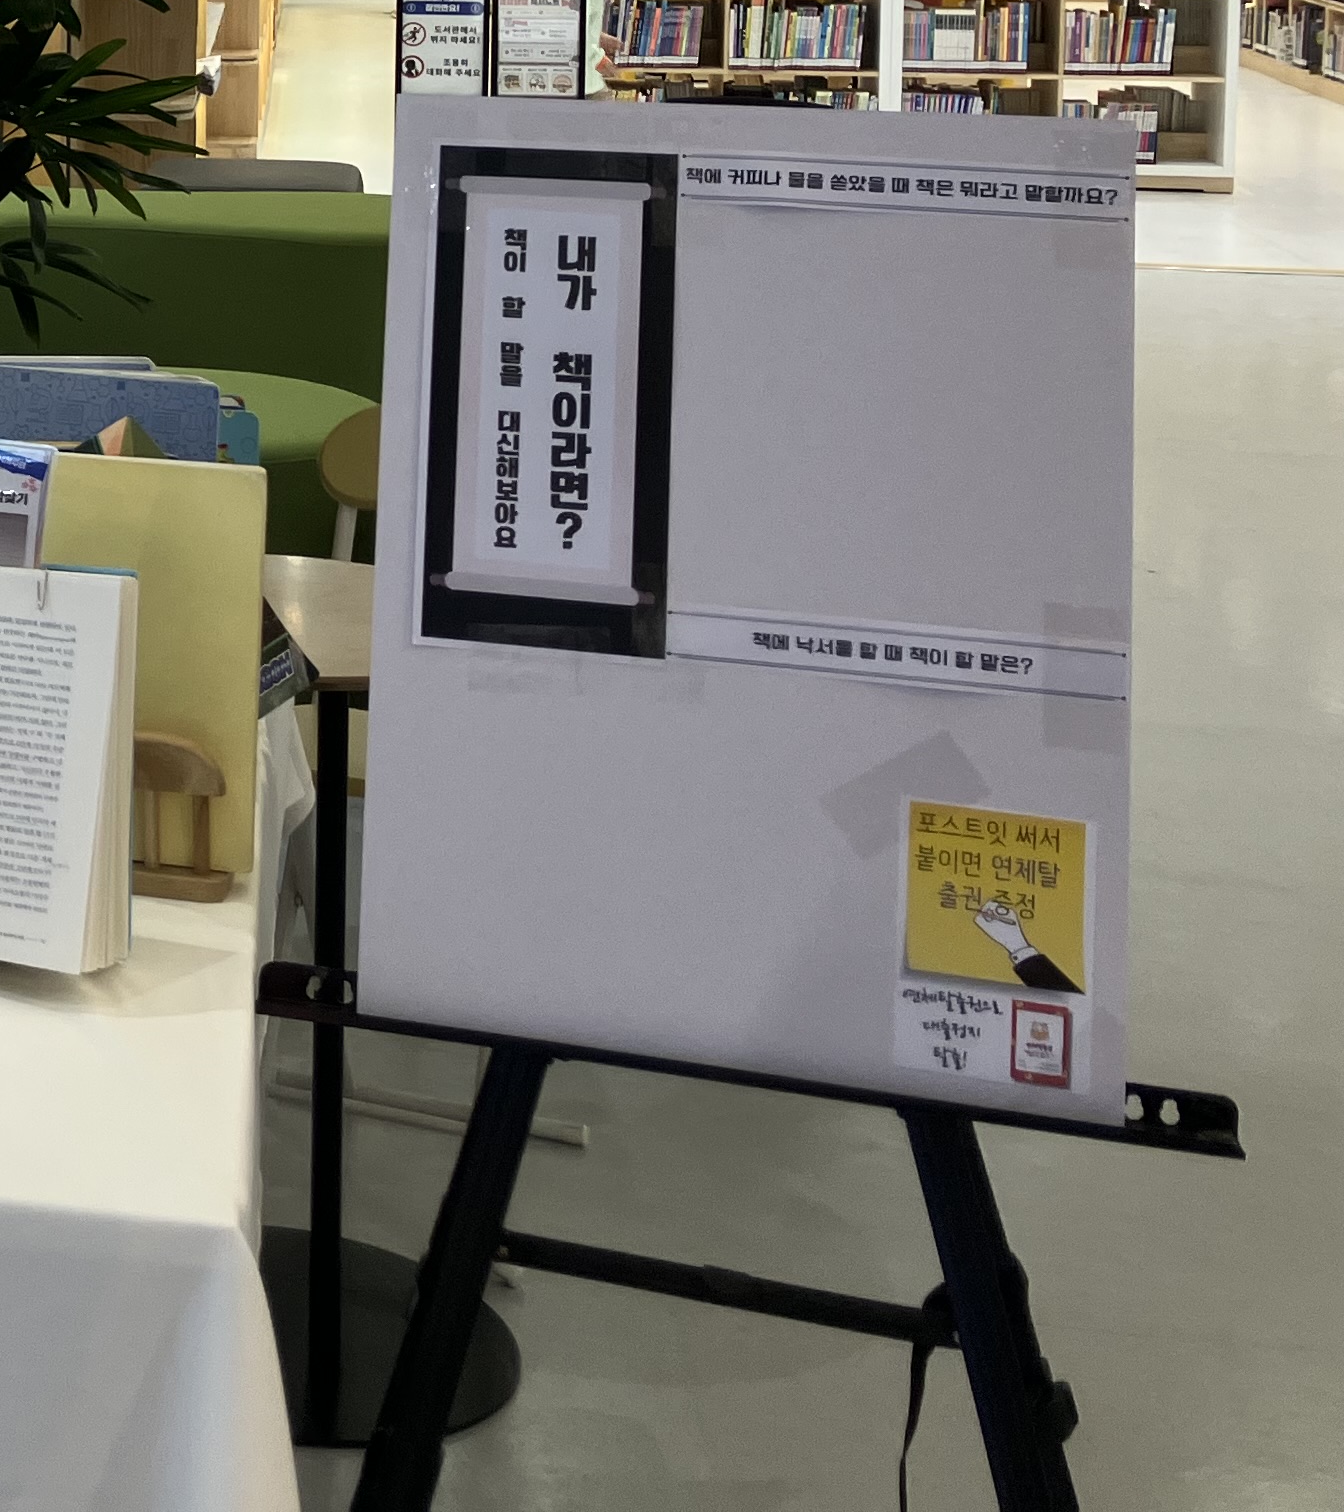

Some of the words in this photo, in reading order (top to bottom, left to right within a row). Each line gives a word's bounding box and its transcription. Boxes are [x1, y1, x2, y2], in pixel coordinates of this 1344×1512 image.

[727, 168, 781, 187] 커피나
[830, 174, 886, 194] 쏟았을
[891, 177, 910, 195] 때
[915, 178, 954, 198] 책은
[959, 181, 1018, 200] 뭐라고
[1025, 184, 1118, 206] 말할까요?
[503, 228, 528, 273] 책이
[557, 234, 597, 311] 내가
[502, 295, 526, 319] 할
[500, 341, 524, 388] 말을
[550, 351, 593, 550] 책이라면?
[493, 409, 522, 549] 대신해보아요
[796, 636, 853, 658] 낙서를
[884, 644, 903, 662] 때
[980, 653, 1034, 675] 말은?
[914, 811, 1009, 848] 포스트잇
[1016, 823, 1062, 854] 써서
[914, 844, 983, 880] 붙이면
[991, 853, 1062, 890] 연체탈
[993, 888, 1037, 920] 증정
